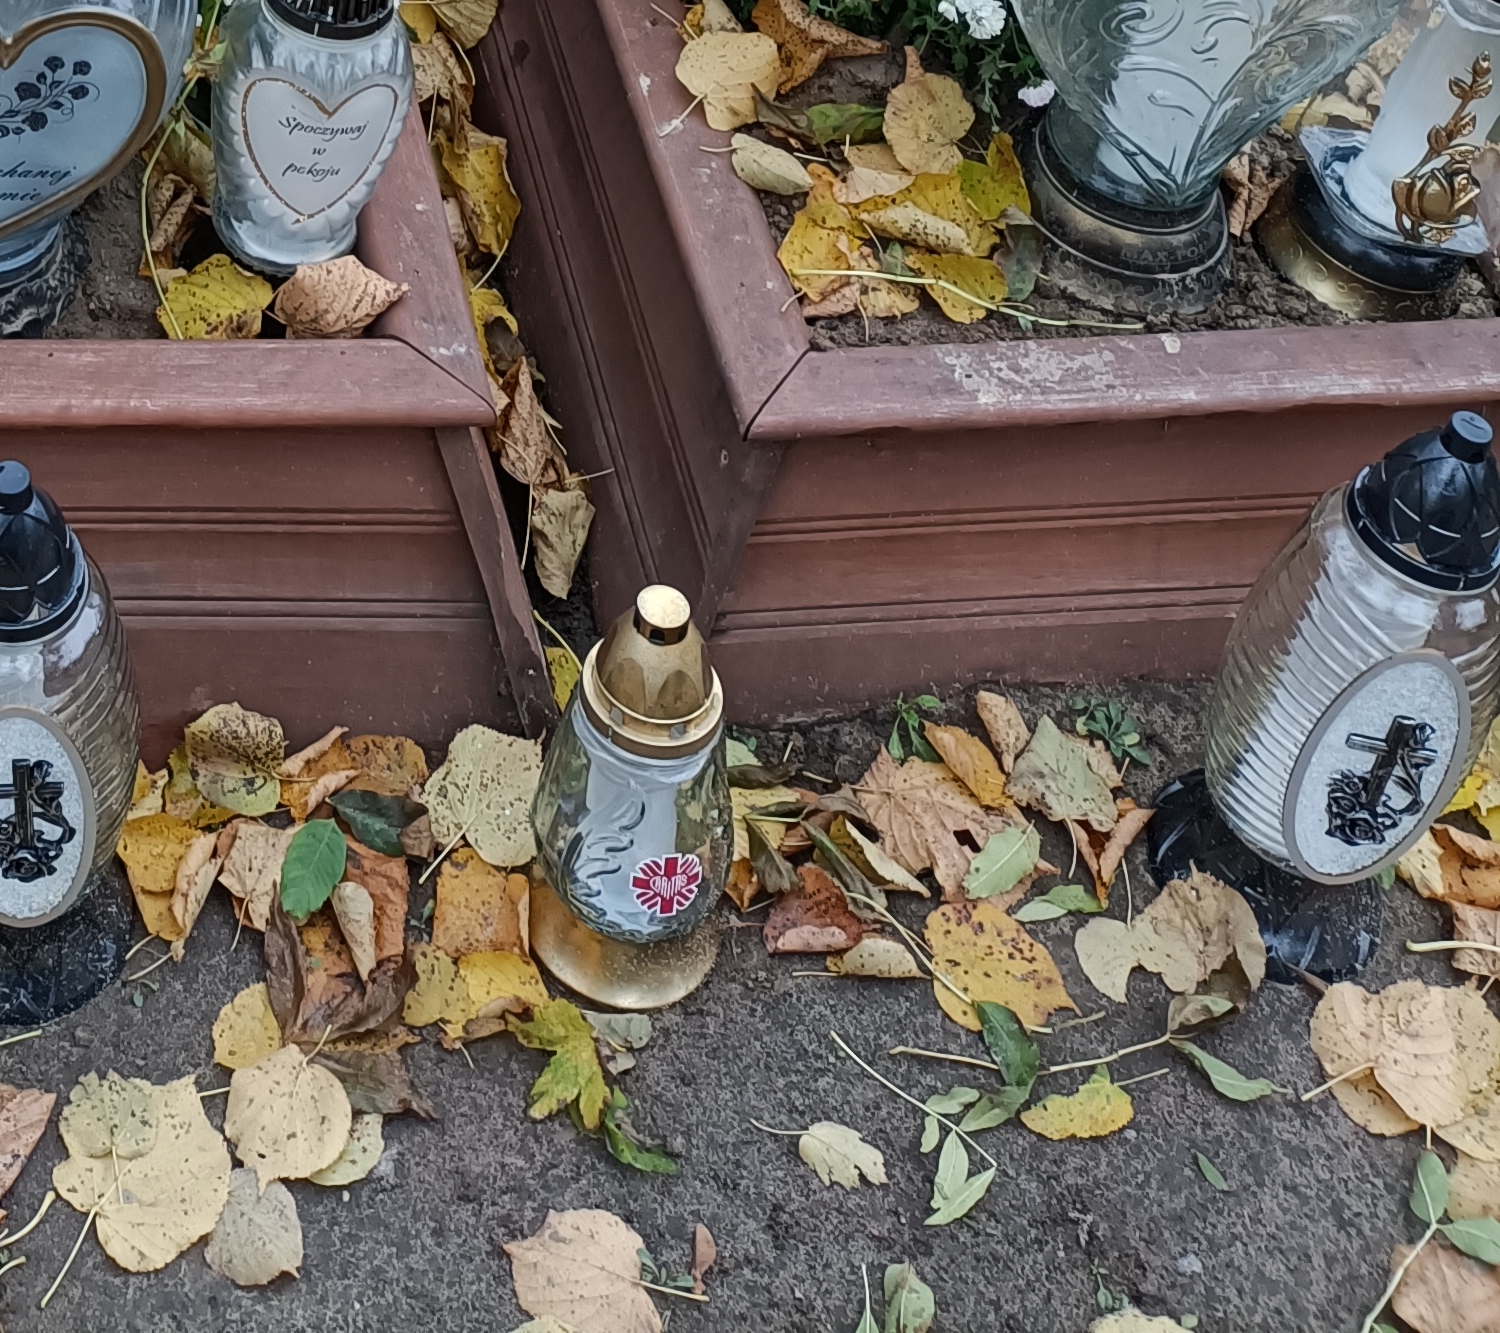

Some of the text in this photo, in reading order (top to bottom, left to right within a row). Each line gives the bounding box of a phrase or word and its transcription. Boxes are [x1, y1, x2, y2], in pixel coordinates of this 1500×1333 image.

[278, 116, 370, 143] Spoczywaj
[311, 147, 327, 156] w
[281, 162, 341, 183] pokoju
[649, 874, 688, 900] CARITAS
